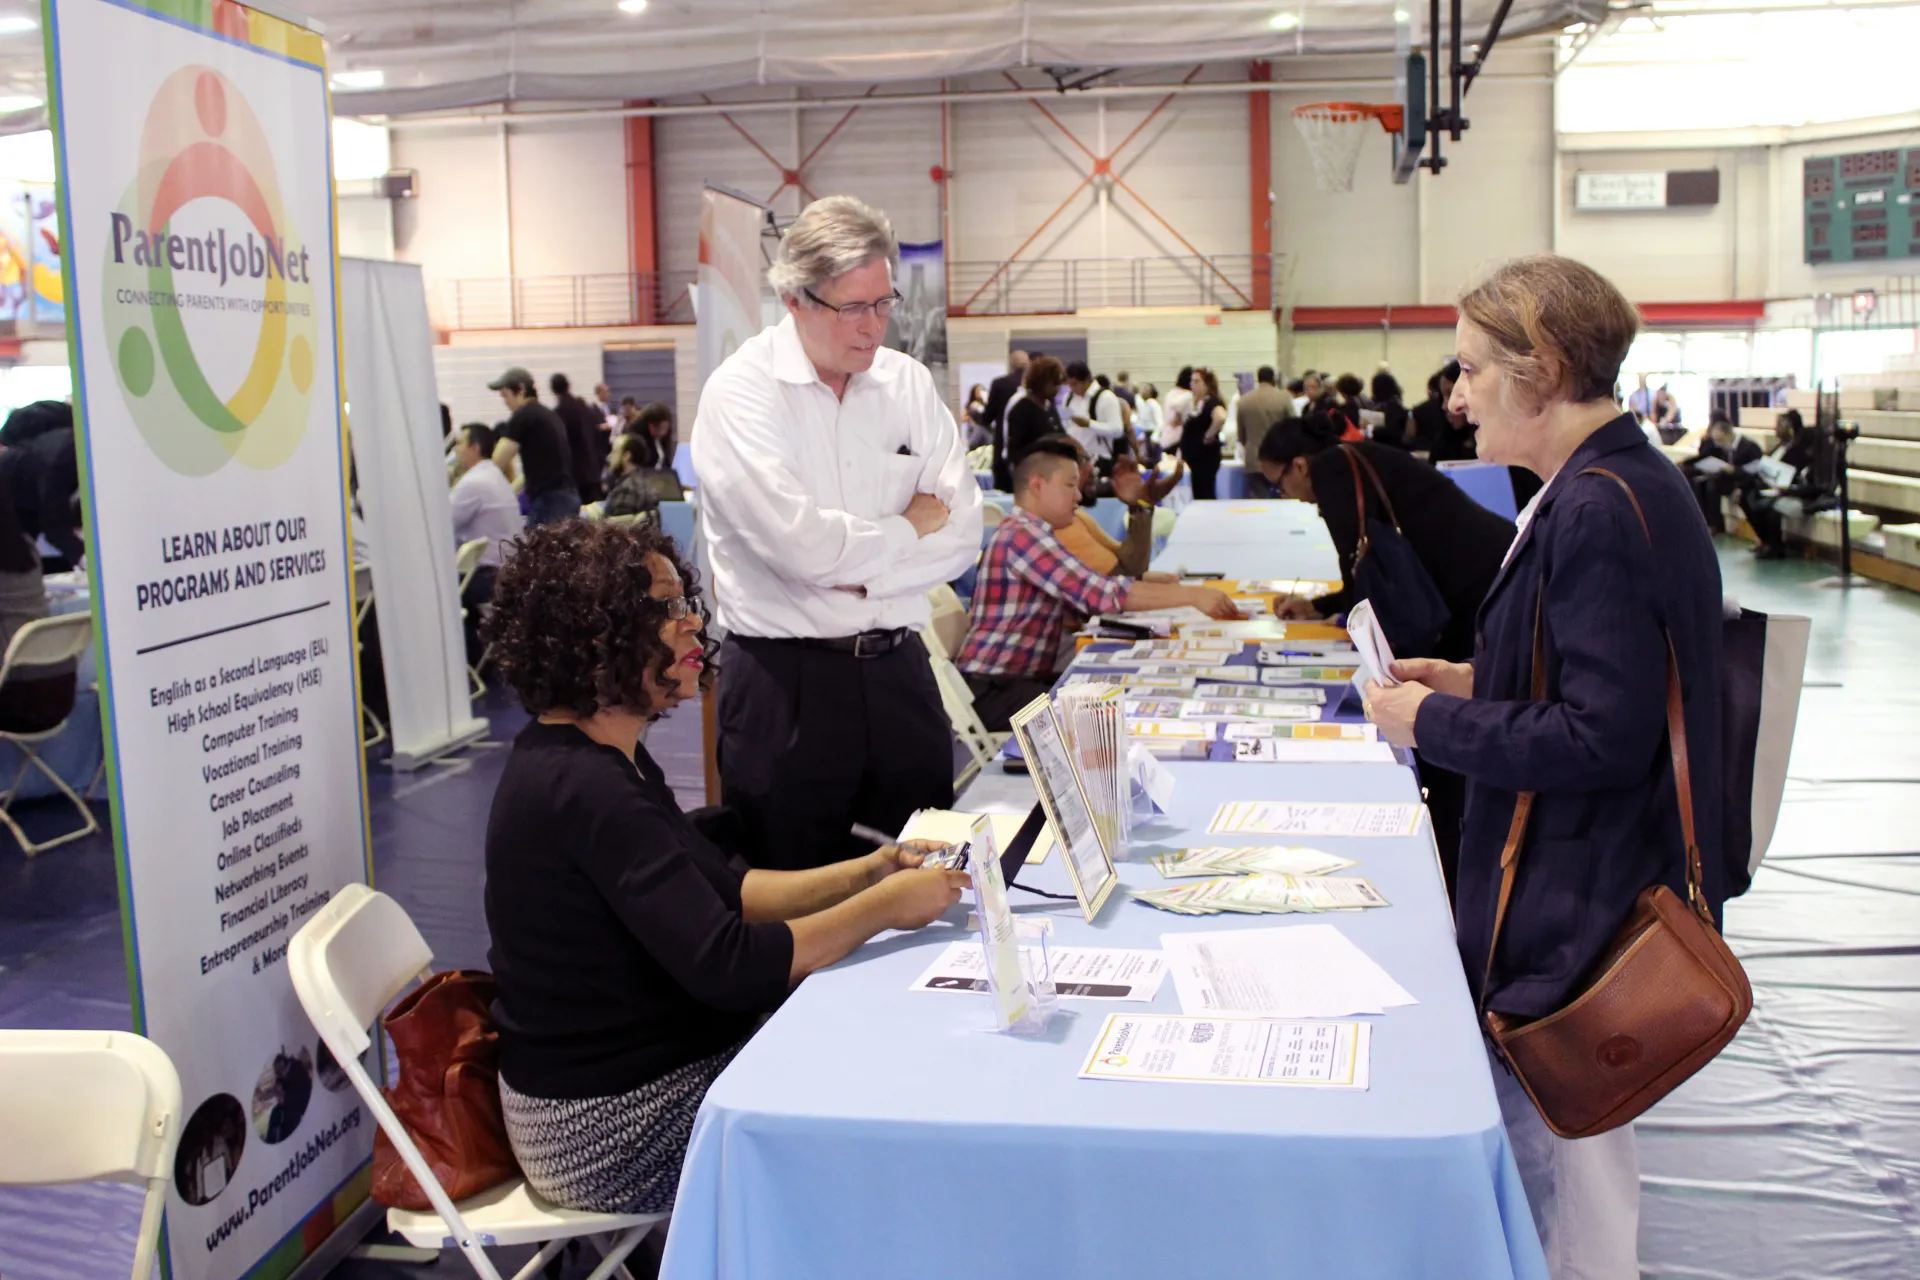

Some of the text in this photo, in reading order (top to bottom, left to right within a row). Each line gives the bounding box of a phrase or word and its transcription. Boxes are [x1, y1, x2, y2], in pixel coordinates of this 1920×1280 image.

[111, 212, 310, 287] ParentJobNet
[116, 288, 310, 317] CONNECTING PARENTS WITH OPPORTUNITIES
[162, 517, 307, 563] LEARN ABOUT OUR
[136, 549, 326, 611] PROGRAMS AND SERVICES
[150, 637, 329, 707] English as a Second Language (ESL)
[167, 667, 322, 734] High School Equivalency (HSE)
[202, 707, 299, 752] Computer Training
[202, 734, 302, 783] Vocational Training
[210, 763, 300, 812] Career Counseling
[217, 816, 302, 871] Online Classifieds
[222, 792, 294, 841] Job Placement
[215, 844, 309, 904] Networking Events
[220, 873, 309, 932] Financial Literacy
[200, 889, 330, 976] Entrepreneurship Training
[252, 955, 261, 975] &
[206, 1105, 361, 1253] www.ParentJobNet.org
